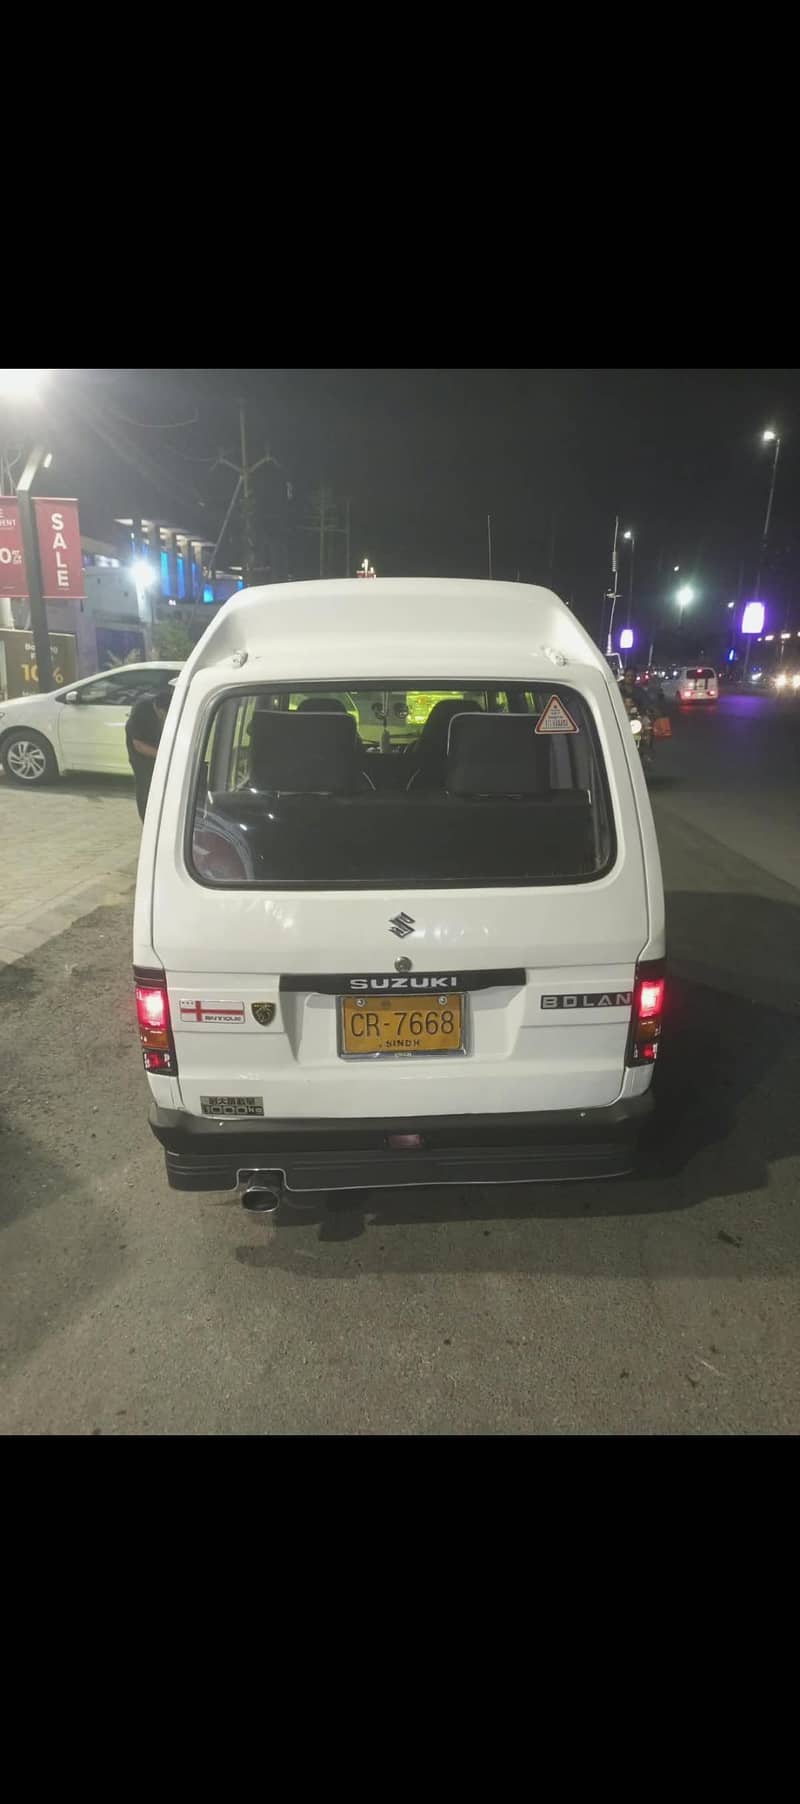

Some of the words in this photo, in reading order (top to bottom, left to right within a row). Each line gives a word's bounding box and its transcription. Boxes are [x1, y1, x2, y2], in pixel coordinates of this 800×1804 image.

[51, 512, 70, 587] SALE
[350, 976, 457, 989] SUZUKI
[542, 993, 631, 1009] BOLAN
[351, 1010, 454, 1037] CR-7668
[385, 1039, 421, 1048] SINDH
